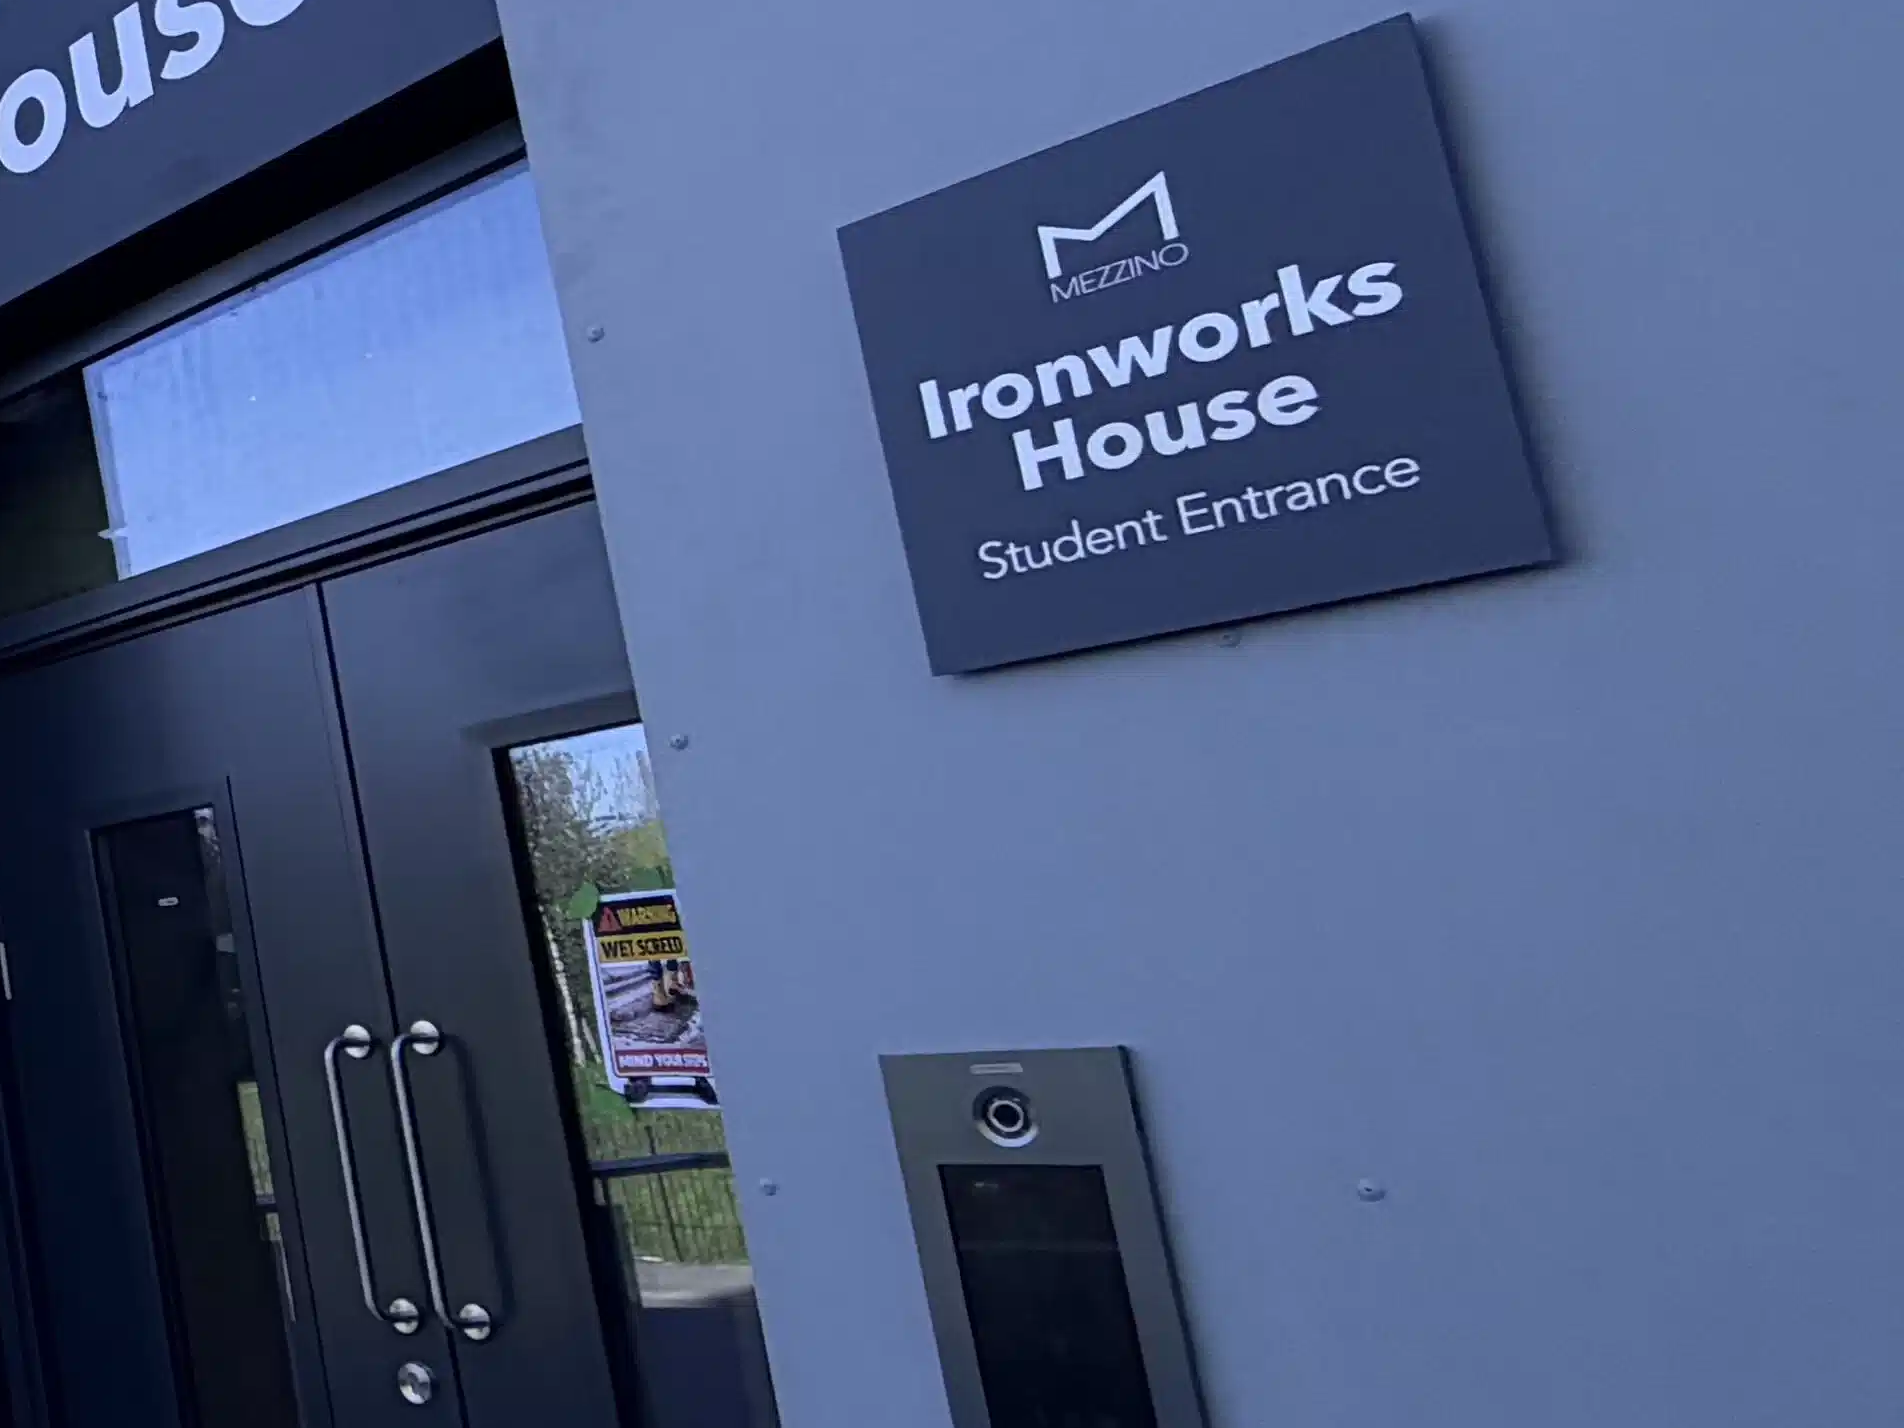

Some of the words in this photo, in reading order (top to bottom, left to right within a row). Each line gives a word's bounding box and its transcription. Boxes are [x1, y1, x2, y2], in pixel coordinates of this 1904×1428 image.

[1050, 243, 1189, 304] MEZZINO
[919, 261, 1403, 439] Ironworks
[1011, 374, 1321, 491] House
[978, 509, 1168, 580] Student
[1176, 456, 1421, 535] Entrance
[600, 939, 634, 959] WET
